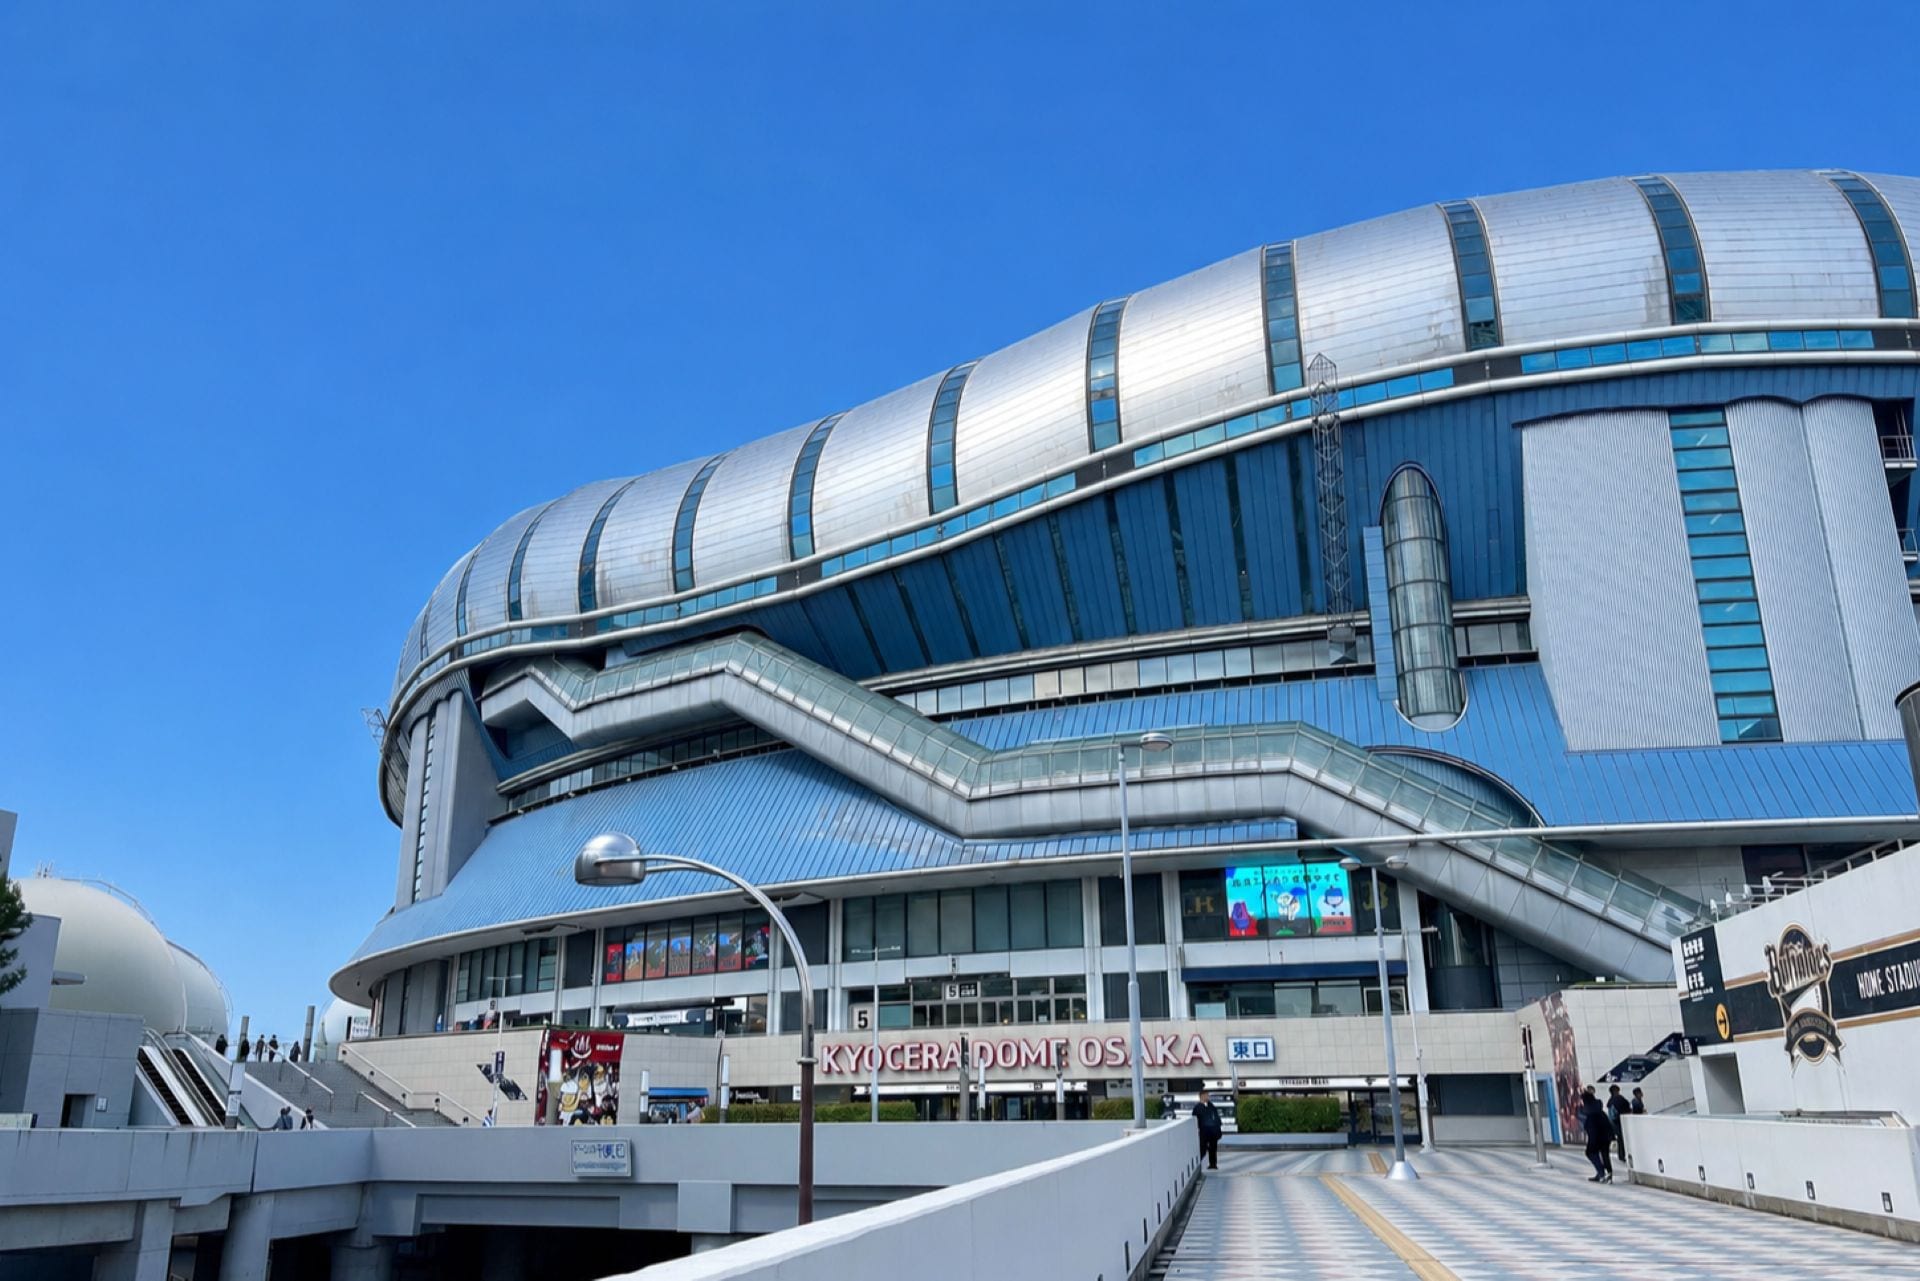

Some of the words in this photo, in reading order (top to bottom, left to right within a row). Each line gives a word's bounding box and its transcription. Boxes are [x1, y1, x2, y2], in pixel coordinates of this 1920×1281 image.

[948, 985, 957, 998] 5
[1856, 968, 1885, 999] HOME
[857, 1009, 868, 1029] 5
[821, 1041, 964, 1074] KYOCERA
[1232, 1041, 1269, 1059] 東口
